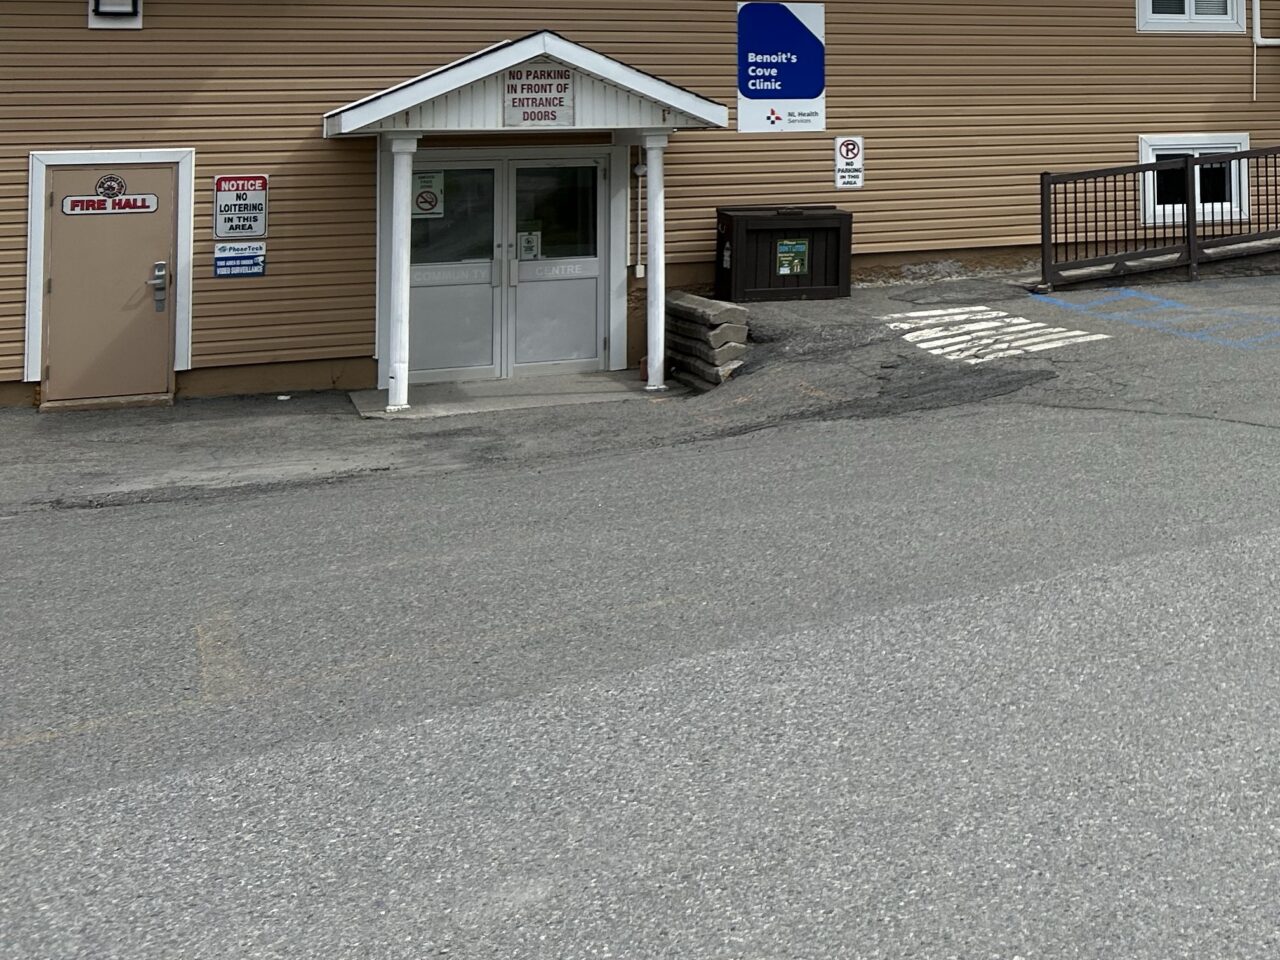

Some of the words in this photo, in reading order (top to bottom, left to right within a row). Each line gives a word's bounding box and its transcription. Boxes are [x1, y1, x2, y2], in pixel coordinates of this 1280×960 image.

[748, 52, 798, 63] Benoit's
[508, 70, 523, 80] NO
[526, 69, 570, 80] PARKING
[748, 66, 778, 76] Cove
[507, 84, 517, 94] IN
[521, 83, 553, 93] FRONT
[556, 83, 569, 93] OF
[748, 79, 782, 90] Clinic
[512, 97, 564, 107] ENTRANCE
[523, 111, 557, 121] DOORS
[221, 180, 263, 191] NOTICE
[235, 192, 248, 201] NO
[70, 199, 107, 211] FIRE
[112, 198, 150, 210] HALL
[219, 203, 264, 212] LOITERING
[414, 269, 487, 282] COMMUNTY
[535, 264, 583, 276] CENTRE
